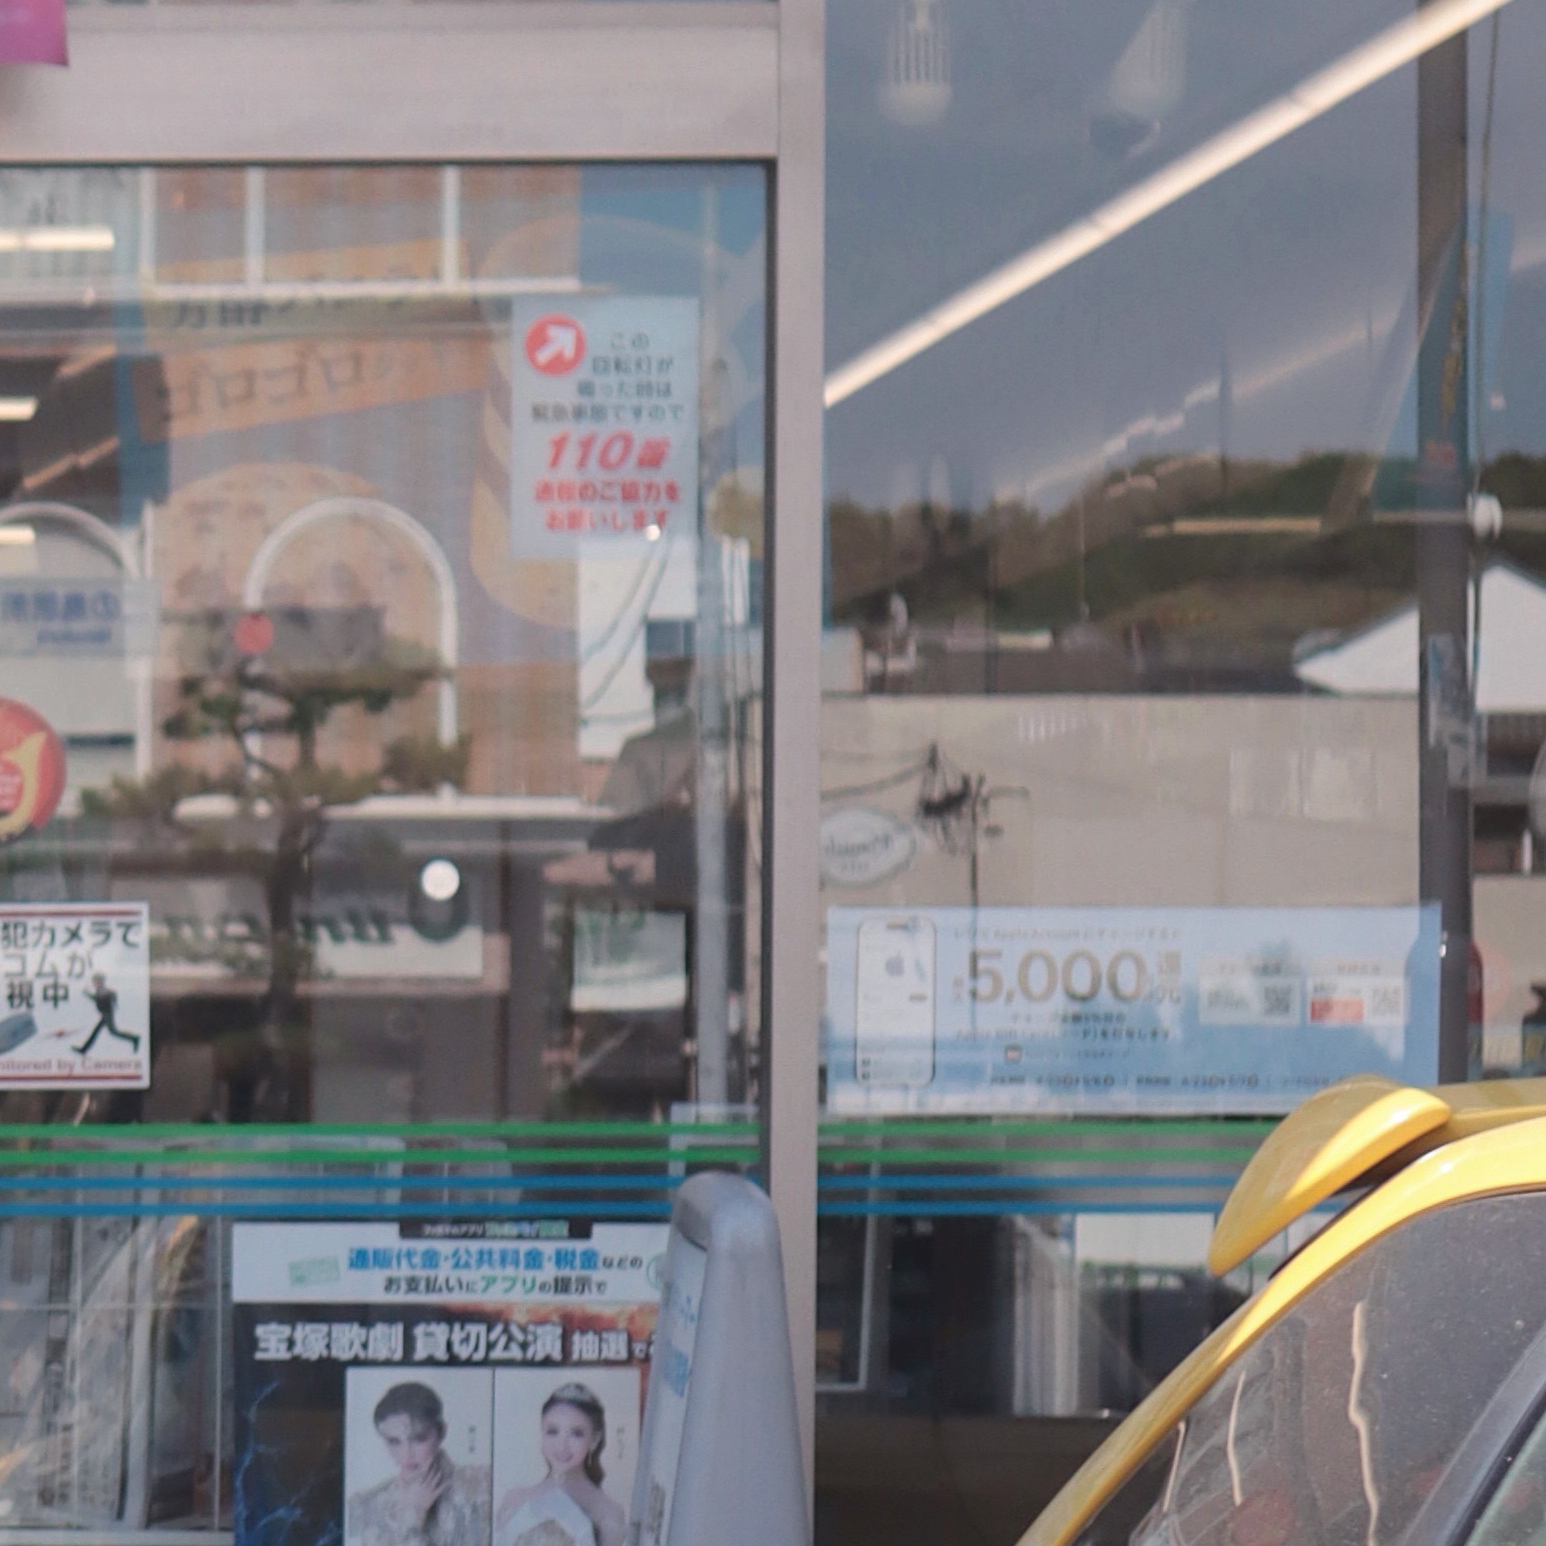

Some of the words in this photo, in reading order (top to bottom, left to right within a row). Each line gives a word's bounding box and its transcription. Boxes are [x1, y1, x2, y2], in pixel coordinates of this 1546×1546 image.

[547, 430, 673, 472] 110番
[969, 948, 1149, 1004] 5,000
[81, 1056, 143, 1072] Camera
[254, 1322, 404, 1362] 宝塚歌劇
[413, 1321, 563, 1362] 貸切公演
